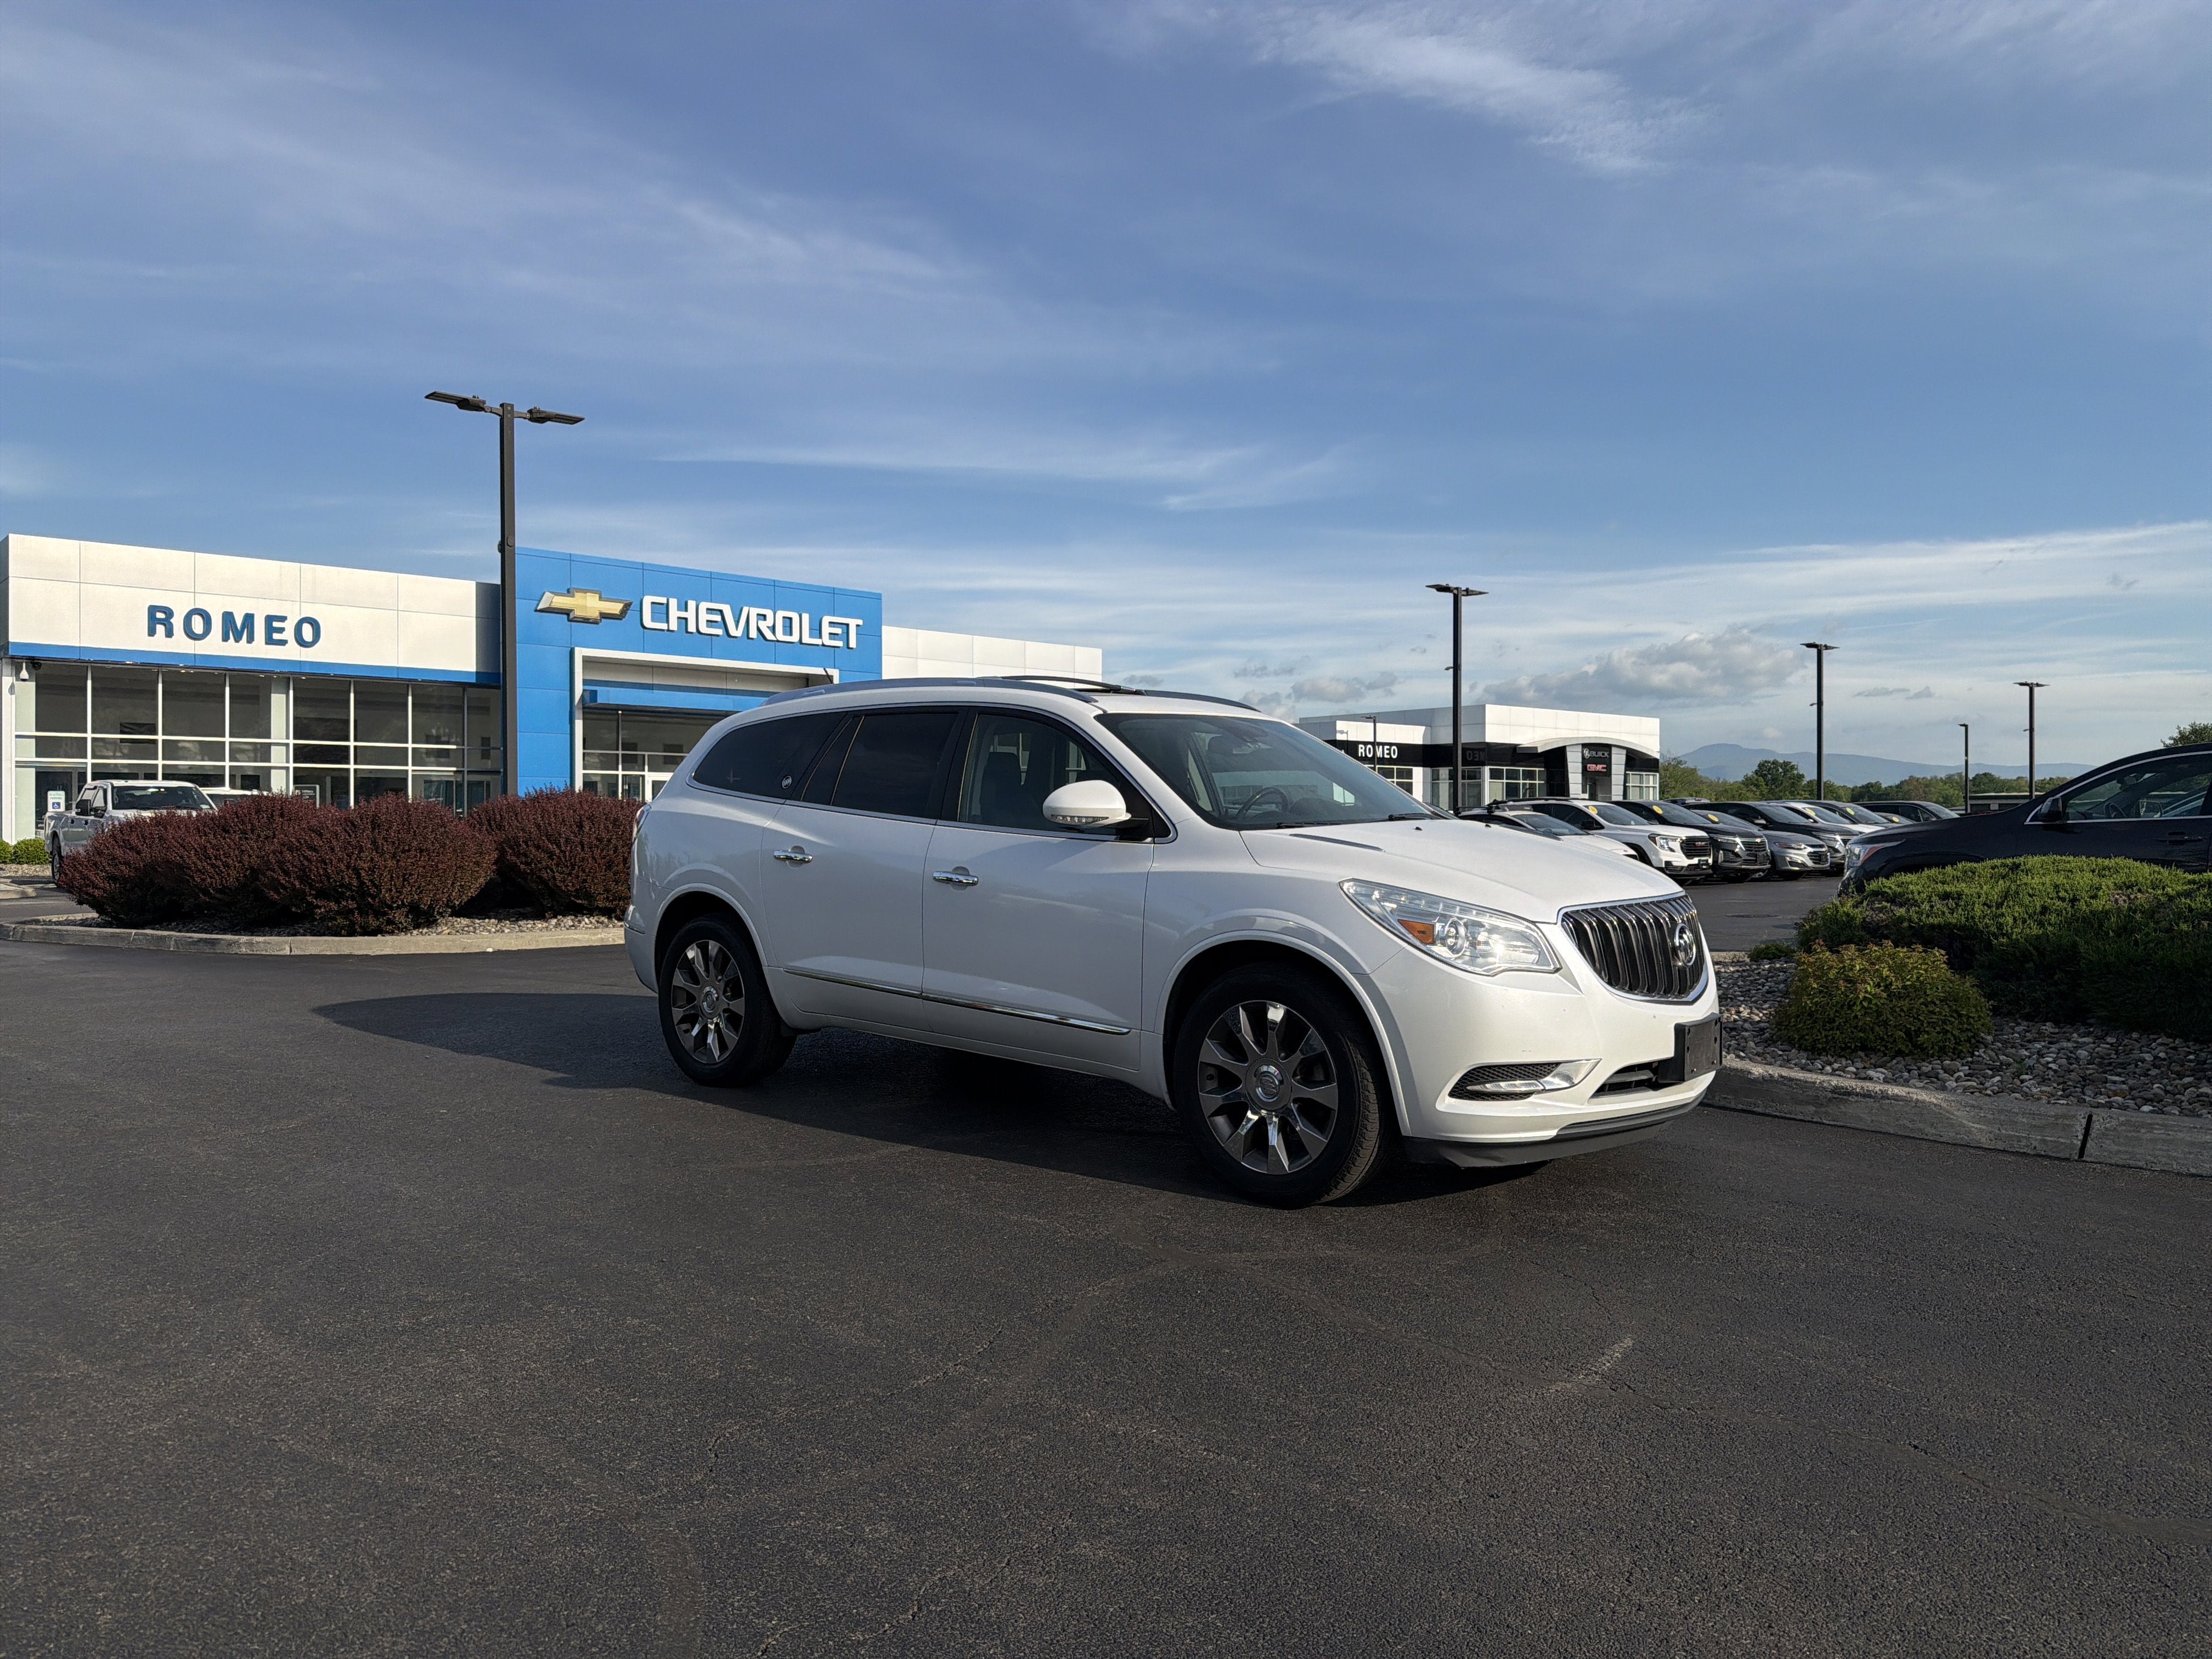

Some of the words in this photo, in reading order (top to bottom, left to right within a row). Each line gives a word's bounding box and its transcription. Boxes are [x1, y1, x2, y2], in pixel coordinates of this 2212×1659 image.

[148, 605, 321, 648] ROMEO
[642, 595, 863, 649] CHEVROLET
[1358, 744, 1398, 759] ROMEO
[1587, 764, 1607, 772] GMC
